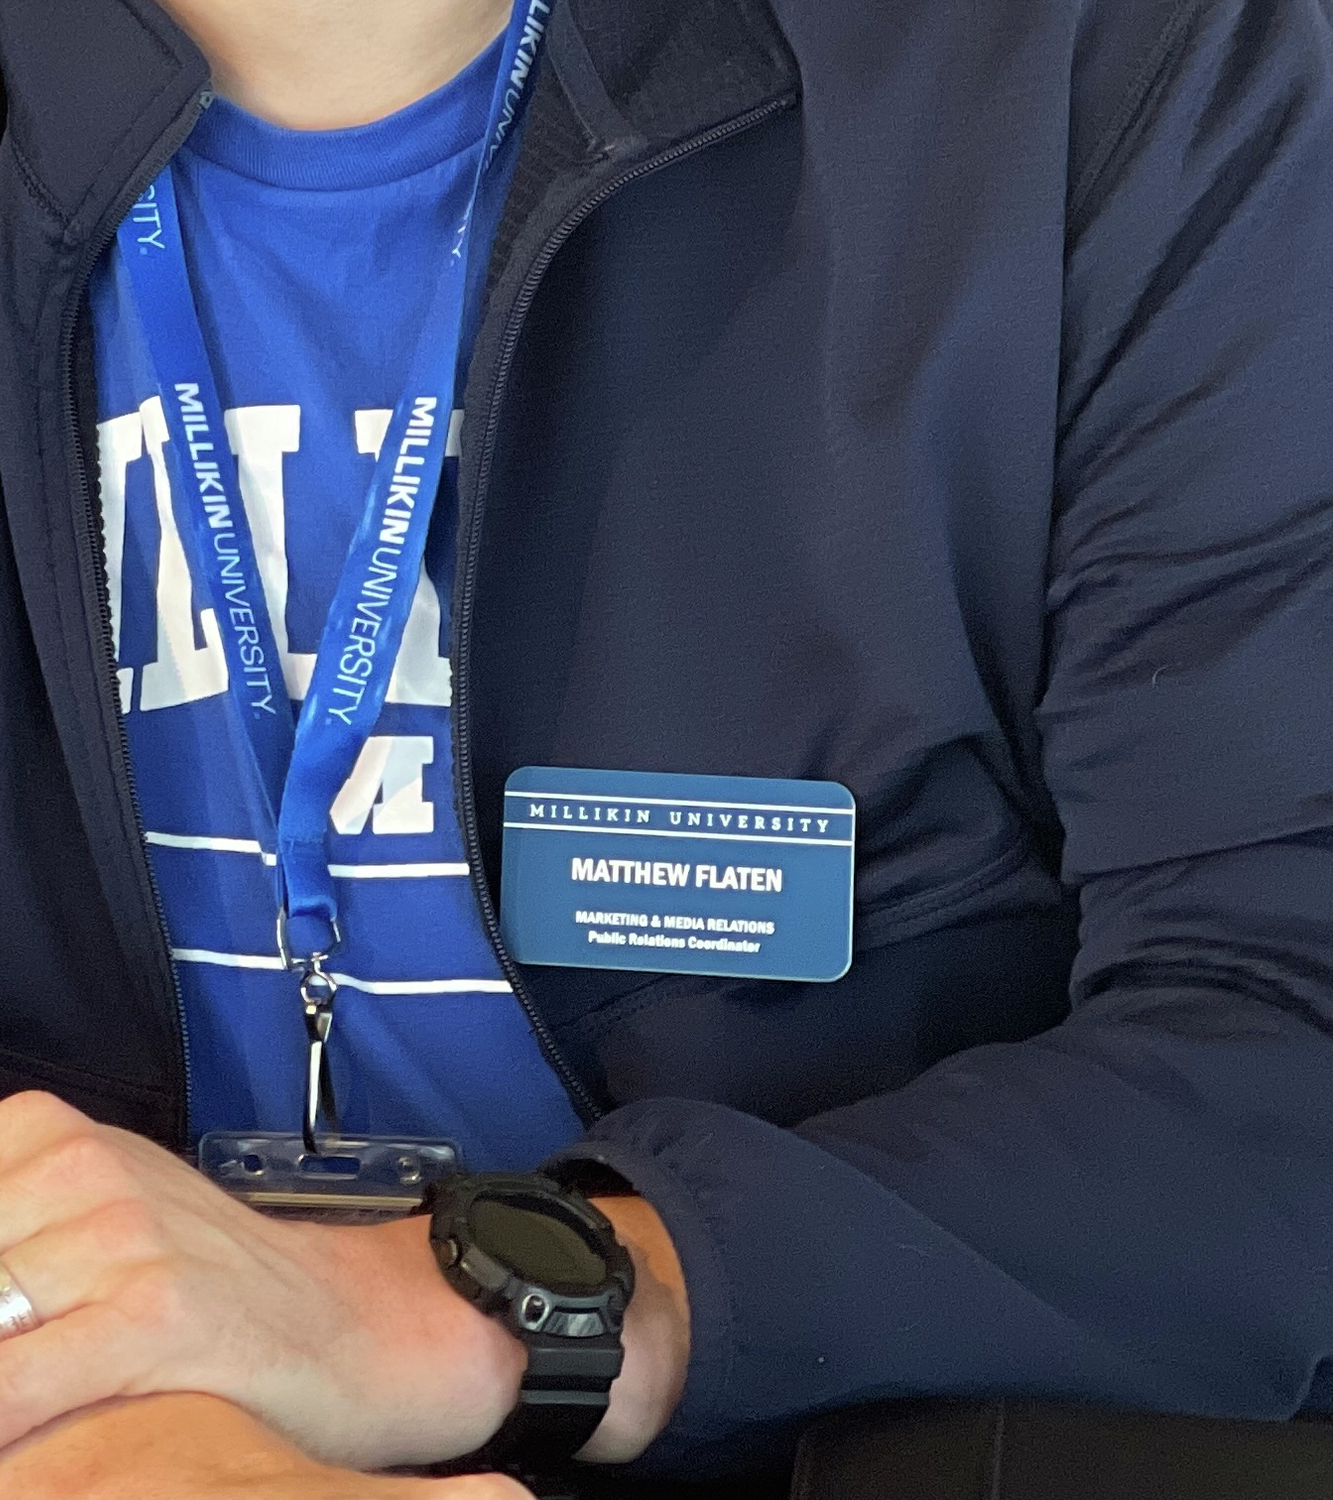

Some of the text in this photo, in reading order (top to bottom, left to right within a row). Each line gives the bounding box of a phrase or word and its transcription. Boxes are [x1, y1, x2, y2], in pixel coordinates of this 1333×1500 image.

[174, 383, 233, 529] MILLIKIN
[380, 397, 437, 544] MILLIKIN
[530, 804, 829, 833] MILLIKIN UNIVERSITY
[571, 857, 783, 892] MATTHEW FLATEN
[575, 910, 775, 934] MARKETING & MEDIA RELATIONS
[588, 930, 761, 953] Public Relations Coordinator
